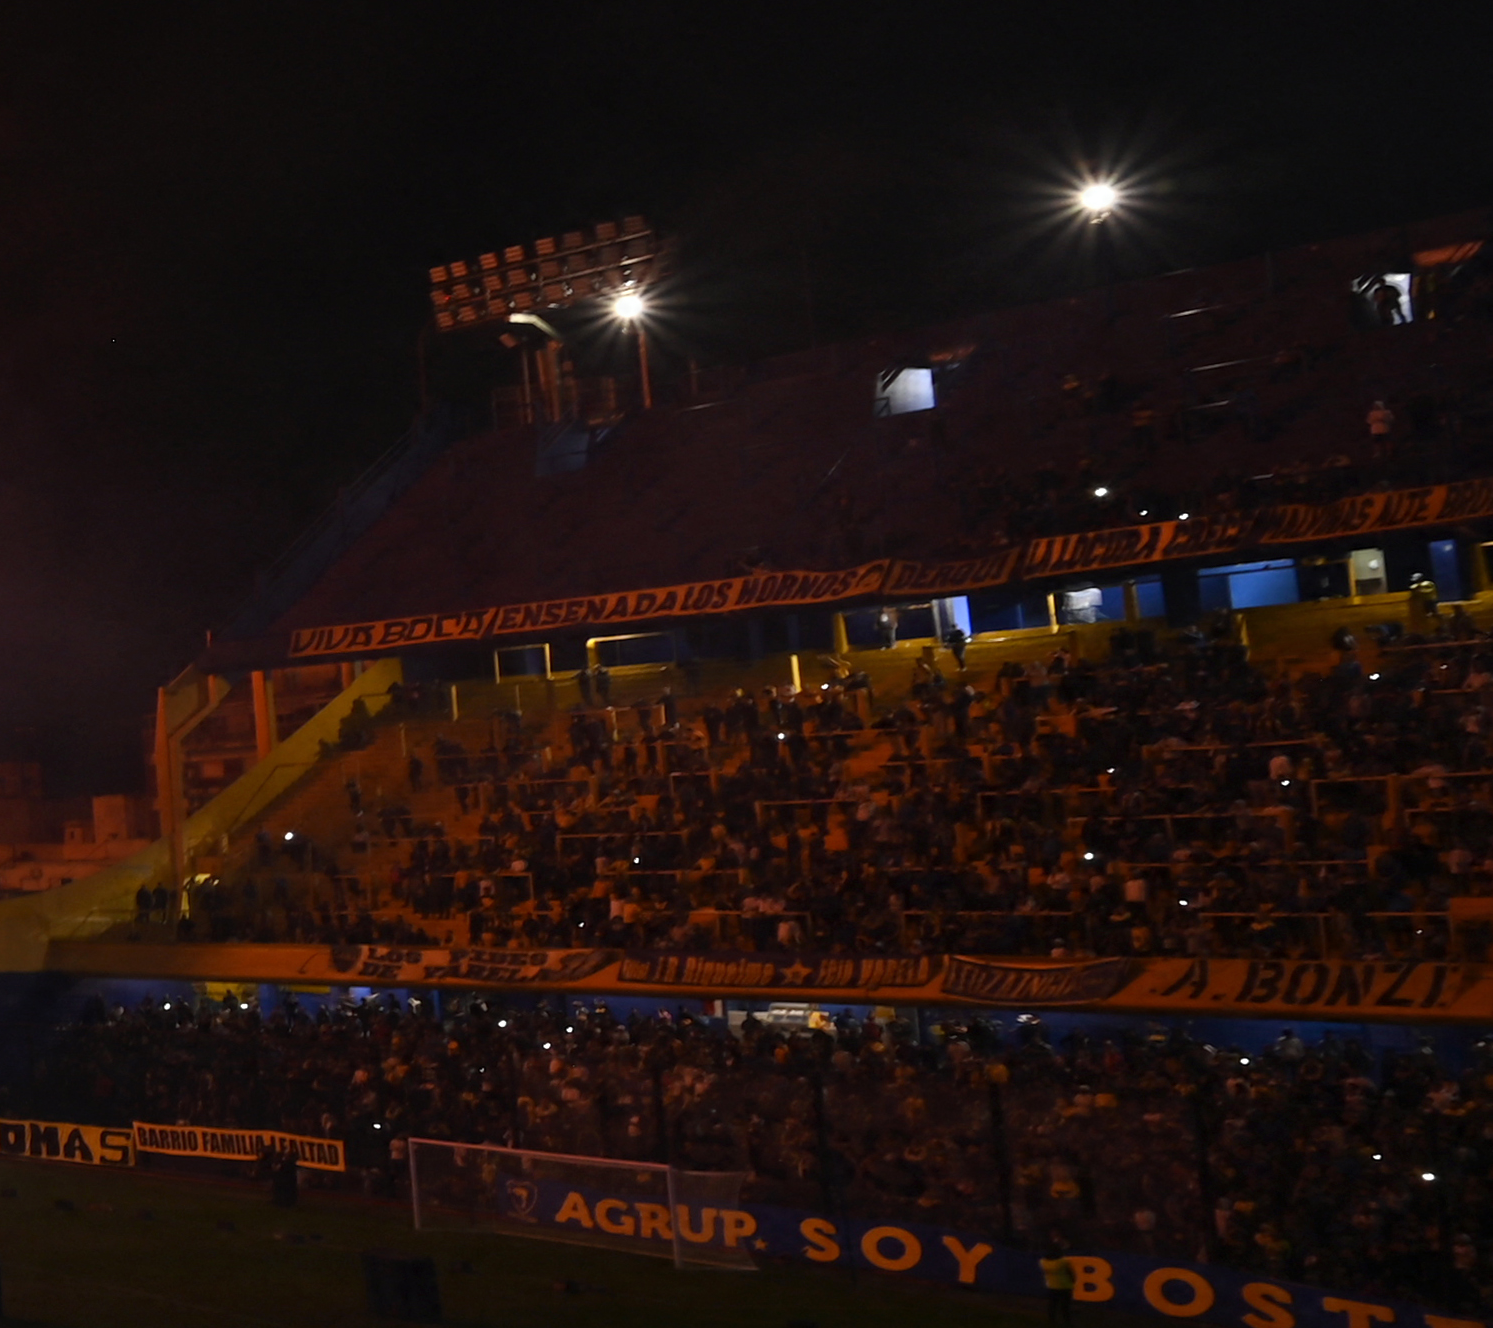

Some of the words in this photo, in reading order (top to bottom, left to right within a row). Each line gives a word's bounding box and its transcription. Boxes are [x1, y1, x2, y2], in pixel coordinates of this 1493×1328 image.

[498, 590, 677, 631] ENSENADA
[682, 581, 732, 611] LOS
[292, 624, 374, 654] VIVA
[376, 611, 490, 647] BOCA
[137, 1126, 199, 1151] BARRIO
[201, 1130, 263, 1157] FAMILIA
[799, 1217, 994, 1285] SOY
